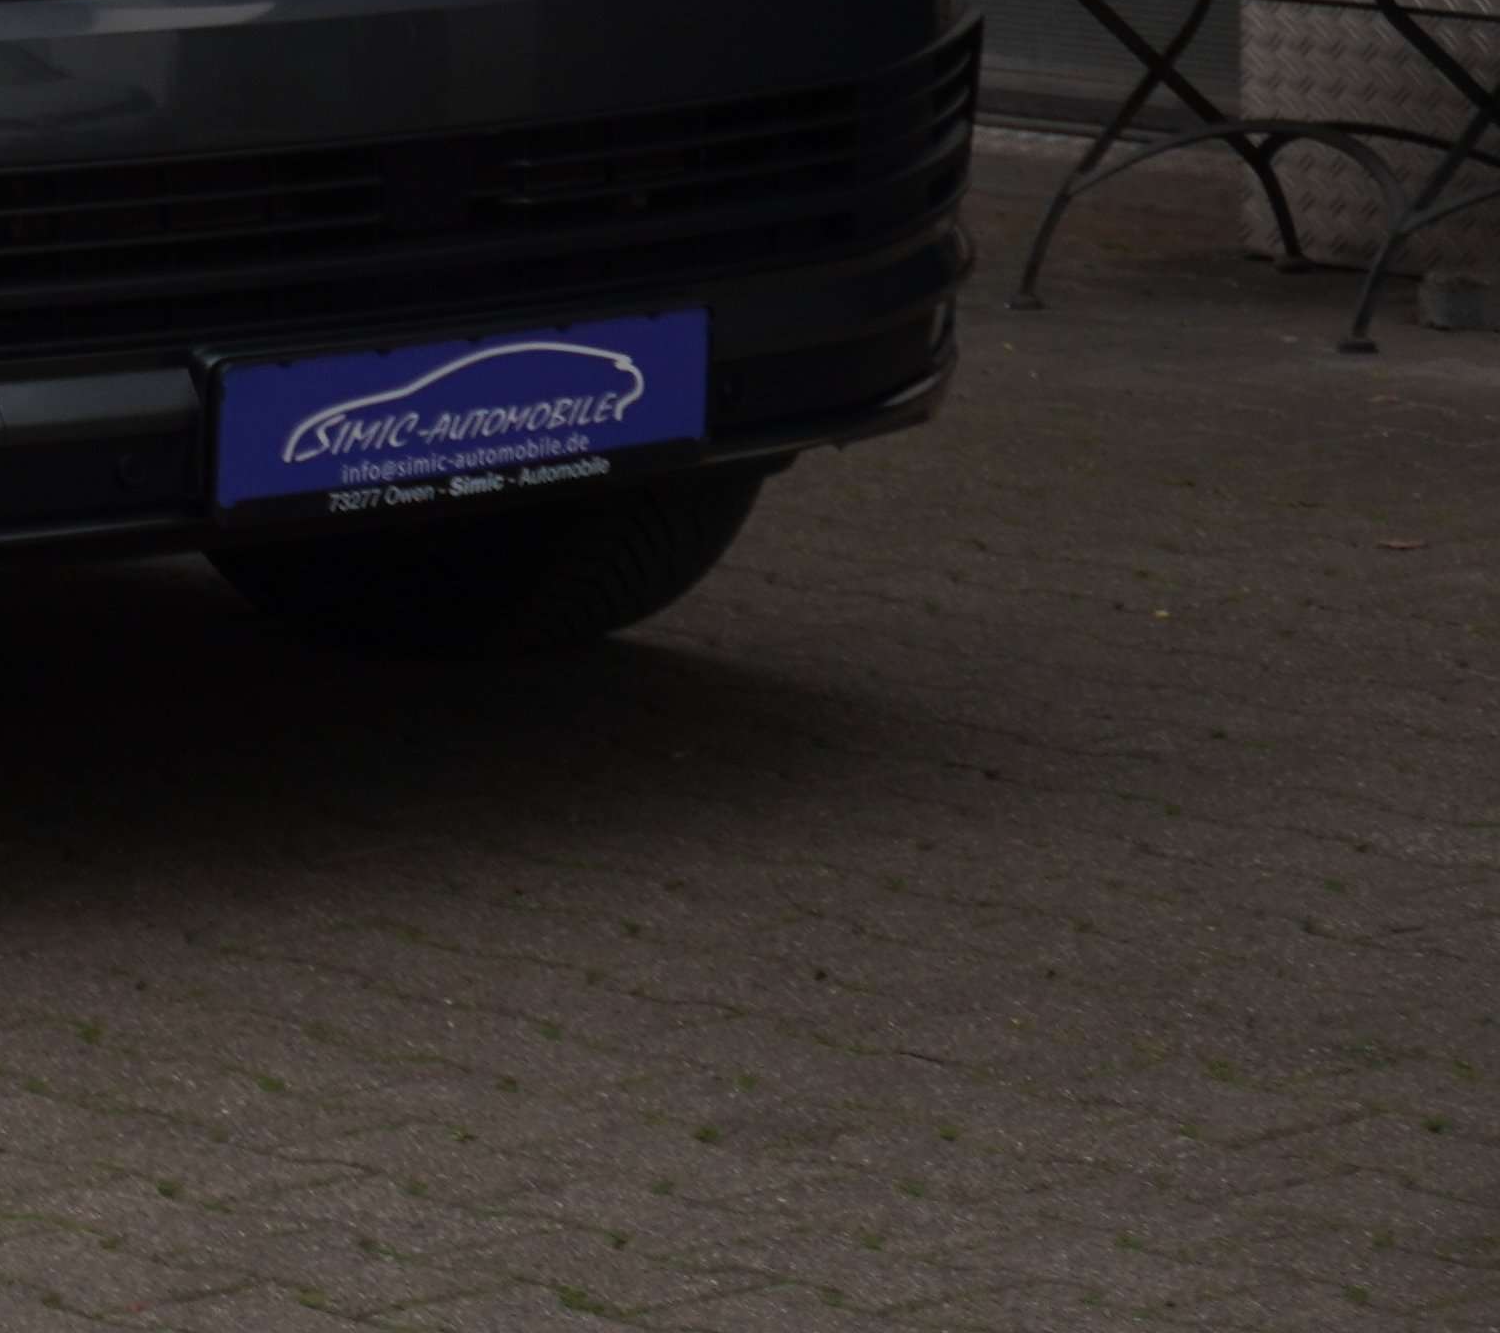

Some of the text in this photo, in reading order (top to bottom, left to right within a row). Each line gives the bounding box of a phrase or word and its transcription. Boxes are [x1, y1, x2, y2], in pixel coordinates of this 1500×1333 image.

[295, 391, 618, 462] SIMIC-AUTOMOBILE
[341, 432, 591, 485] info@simic-automobile.de
[449, 469, 504, 499] Simic
[517, 455, 612, 489] Automobile
